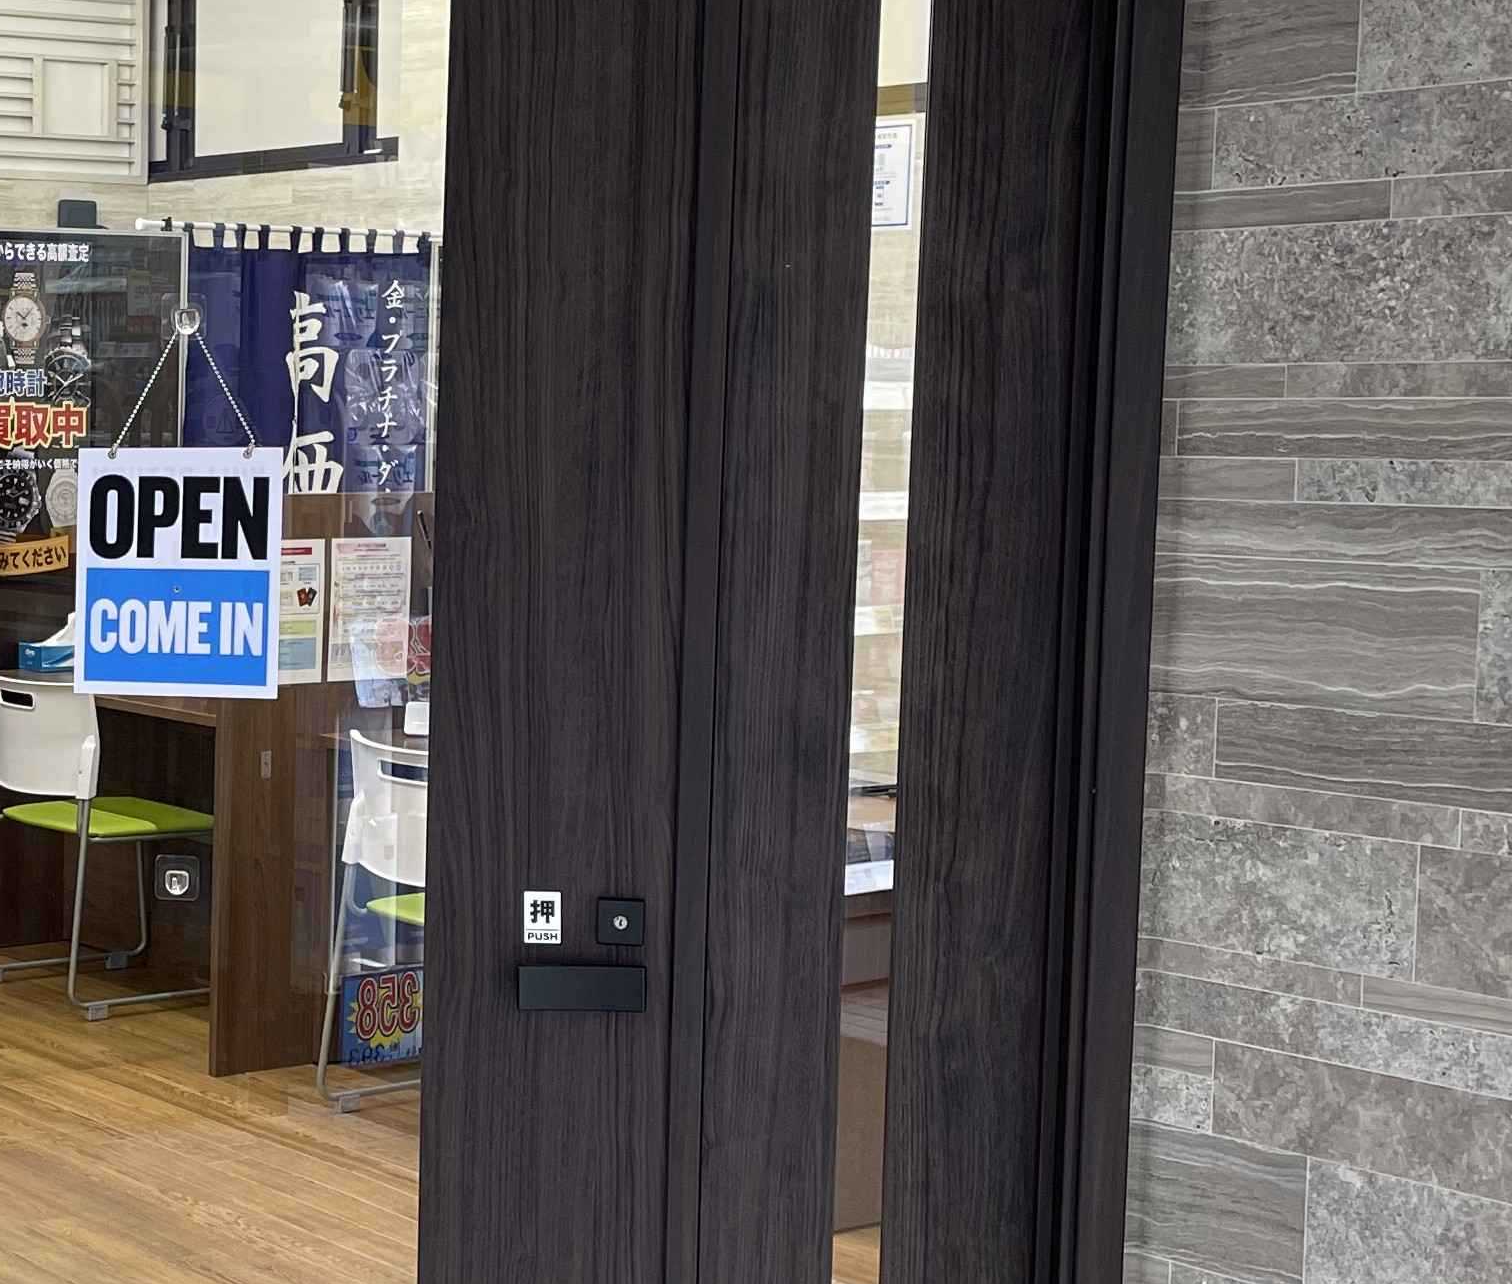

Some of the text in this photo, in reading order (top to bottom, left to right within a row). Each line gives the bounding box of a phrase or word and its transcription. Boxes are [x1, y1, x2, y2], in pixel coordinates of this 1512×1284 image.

[376, 279, 406, 494] 金・プラチナ・ダ
[88, 473, 270, 561] OPEN
[89, 597, 212, 656] COME
[220, 601, 264, 657] IN
[527, 932, 558, 941] PUSH
[530, 899, 555, 924] 押
